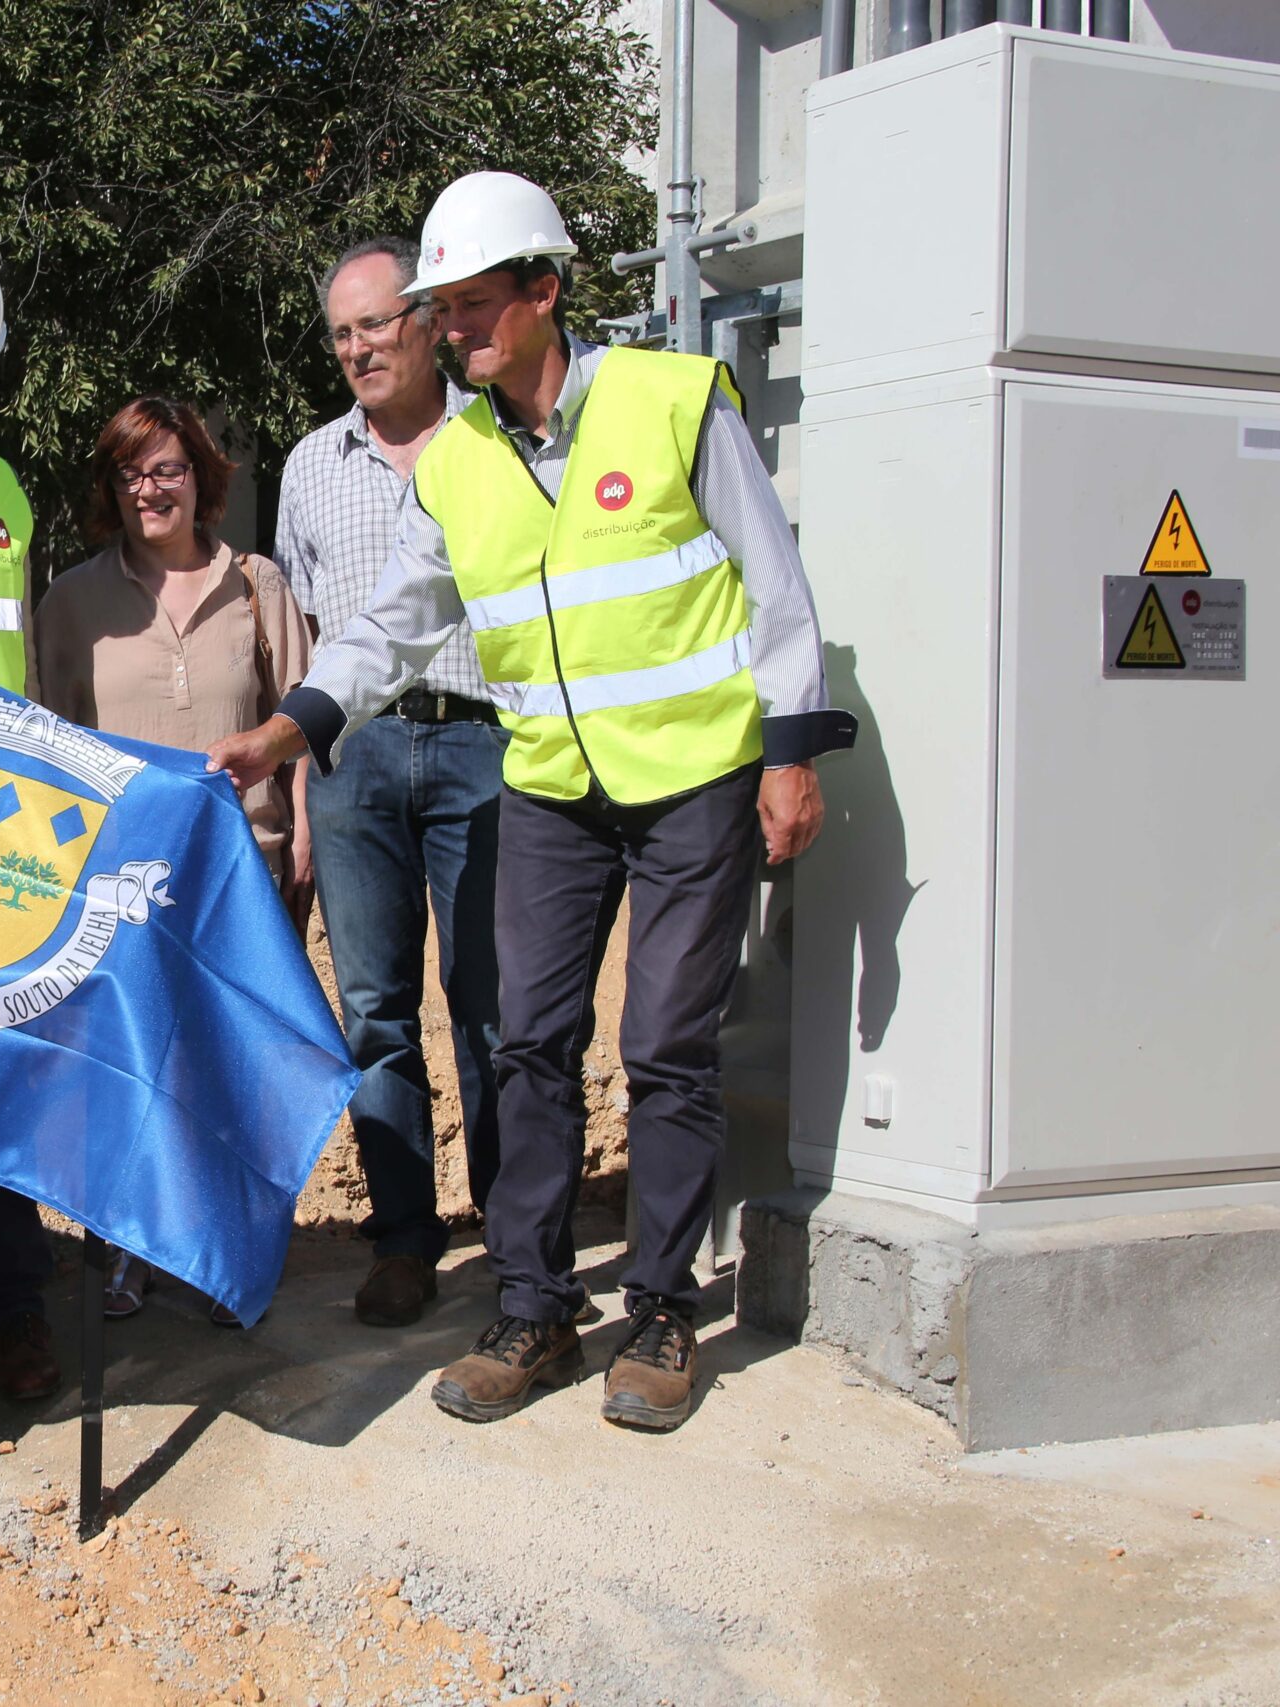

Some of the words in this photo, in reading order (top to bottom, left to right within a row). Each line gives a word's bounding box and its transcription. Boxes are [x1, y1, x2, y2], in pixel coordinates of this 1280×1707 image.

[603, 483, 625, 499] edp
[583, 520, 656, 539] distribuição
[1154, 560, 1171, 568] PERIGO
[1173, 560, 1179, 568] DE
[1181, 560, 1197, 568] MORTE
[3, 976, 64, 1024] SOUTO
[56, 957, 91, 988] DA
[74, 910, 118, 960] VELHA
